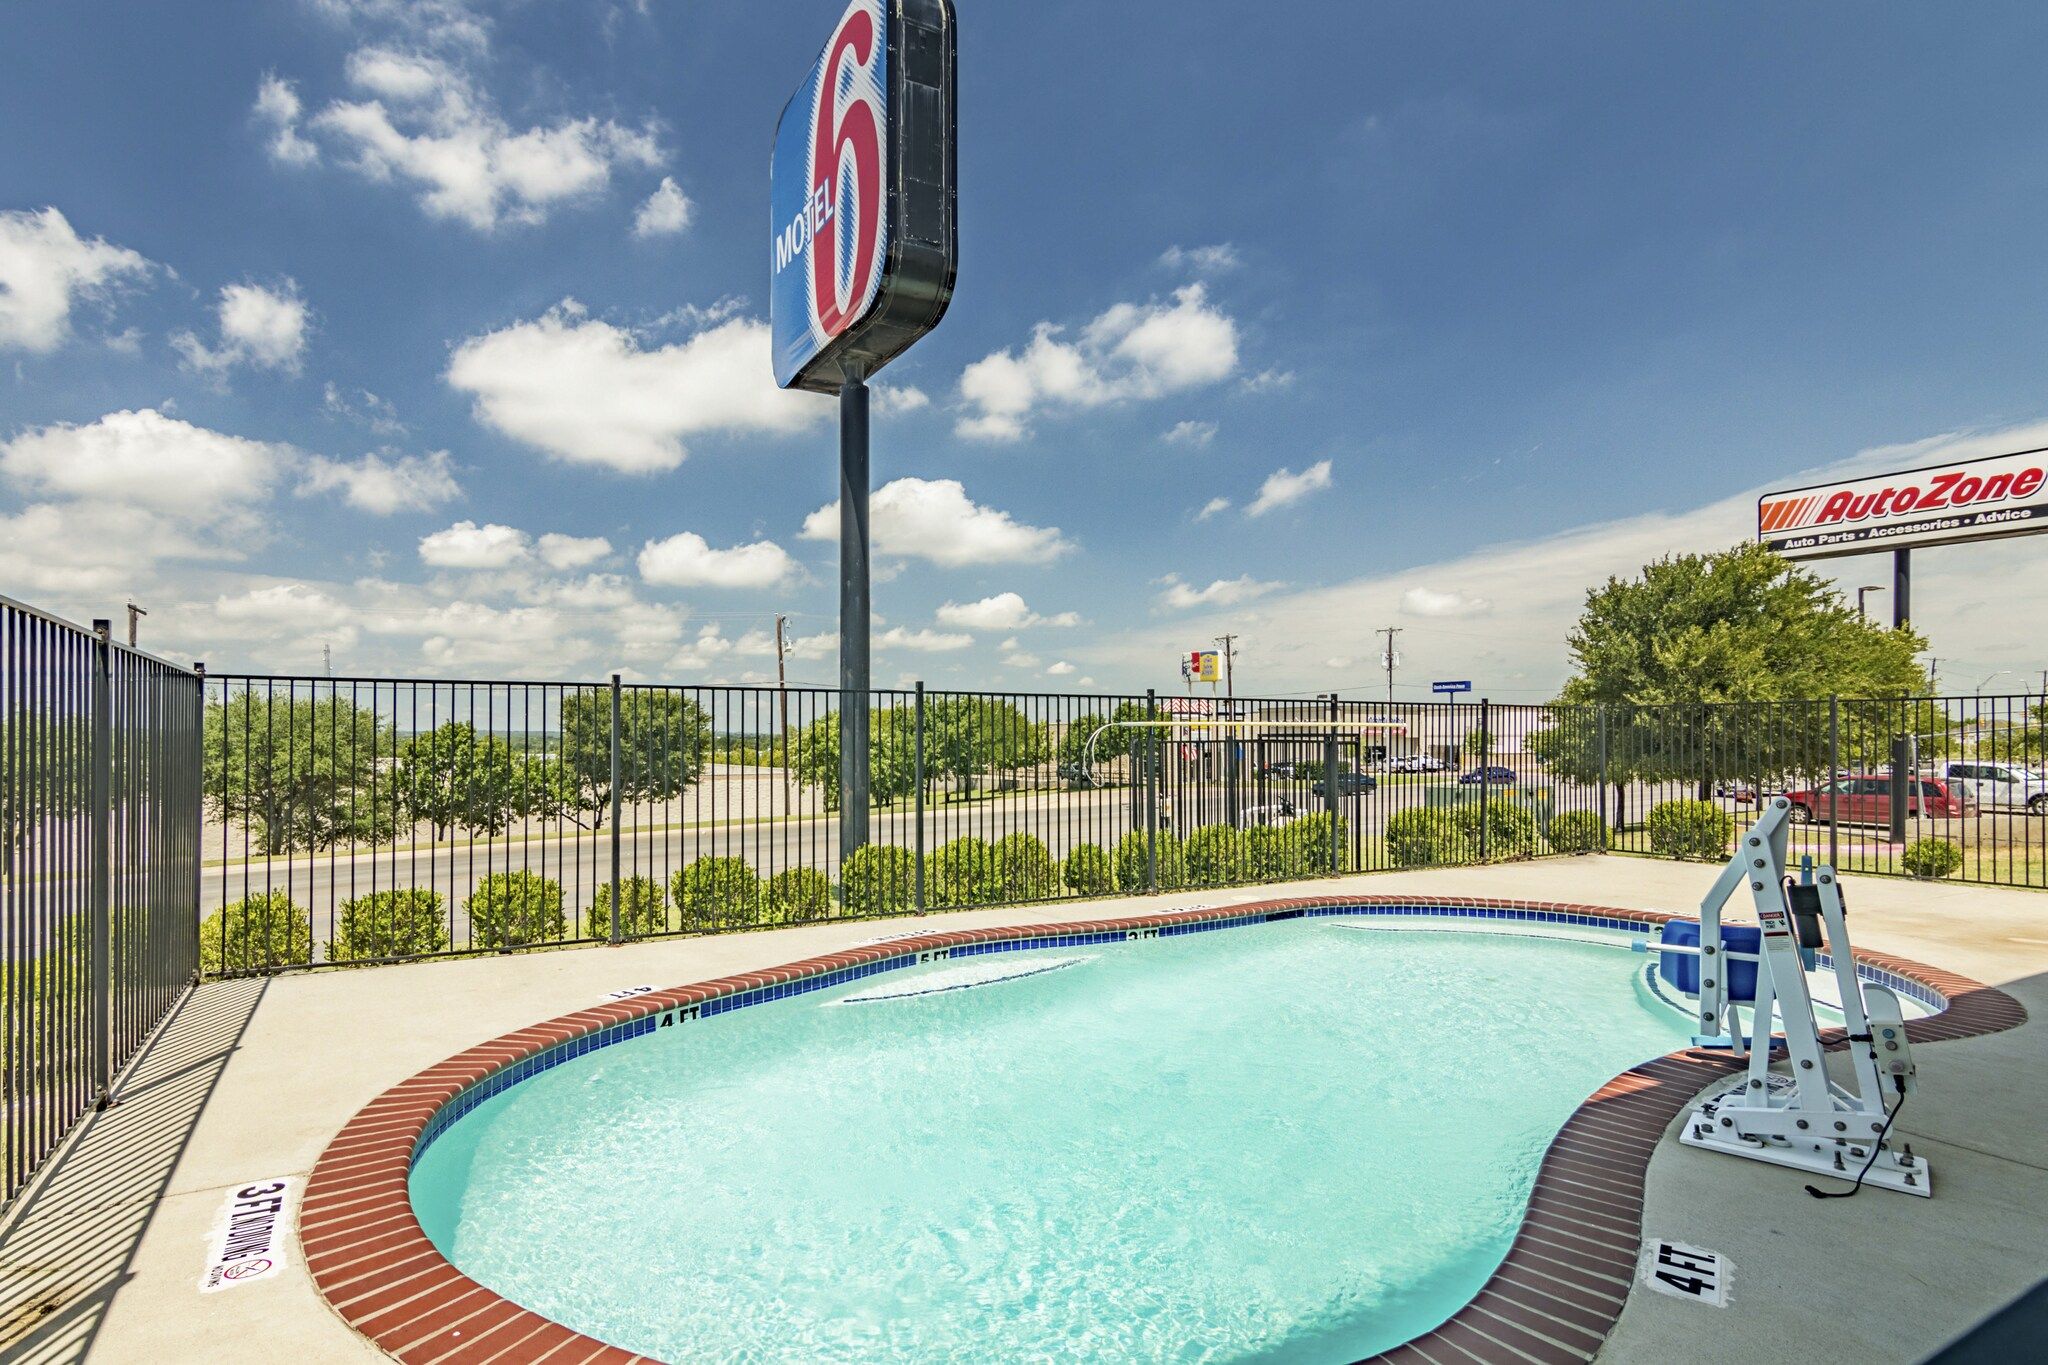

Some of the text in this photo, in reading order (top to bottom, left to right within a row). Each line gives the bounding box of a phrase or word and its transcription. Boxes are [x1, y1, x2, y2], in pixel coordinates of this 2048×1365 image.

[812, 8, 881, 339] 6
[776, 176, 835, 275] MOTEL
[1784, 508, 2032, 550] Auto Parts Accessories Advice
[1814, 466, 2045, 525] AutoZone
